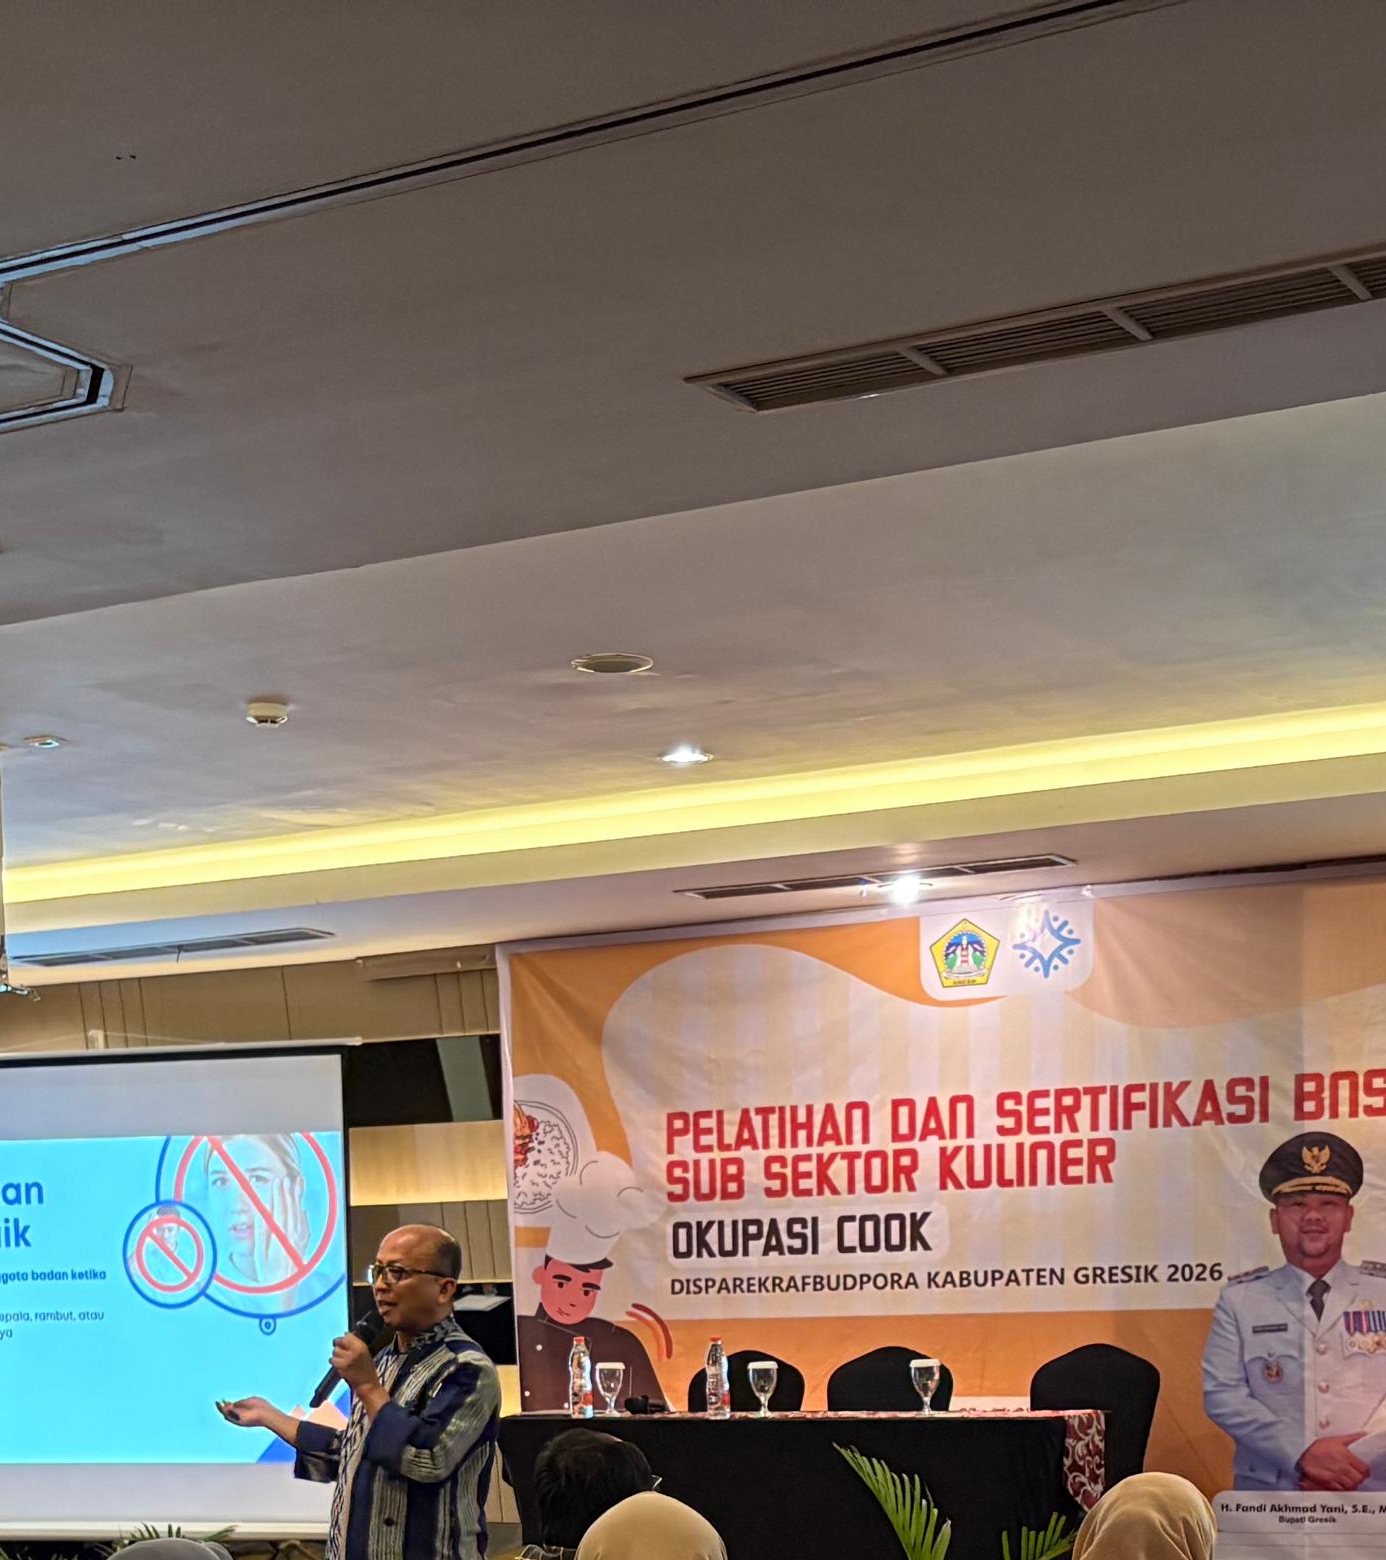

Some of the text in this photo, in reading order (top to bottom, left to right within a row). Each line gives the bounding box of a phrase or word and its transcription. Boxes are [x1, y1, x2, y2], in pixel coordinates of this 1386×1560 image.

[666, 1100, 871, 1155] PELATIHAN
[891, 1094, 975, 1143] DAN
[996, 1075, 1270, 1137] SERTIFIKASI
[666, 1137, 1117, 1202] SUB SEKTOR KULINER
[672, 1211, 933, 1260] OKUPASI COOK
[31, 1269, 69, 1282] badan
[70, 1268, 107, 1281] ketika
[670, 1262, 1224, 1296] DISPAREKRAFBUDPORA KABUPATEN GRESIK 2026
[78, 1310, 105, 1321] atau
[1235, 1502, 1267, 1513] Fandi
[1269, 1503, 1317, 1514] Akhmad
